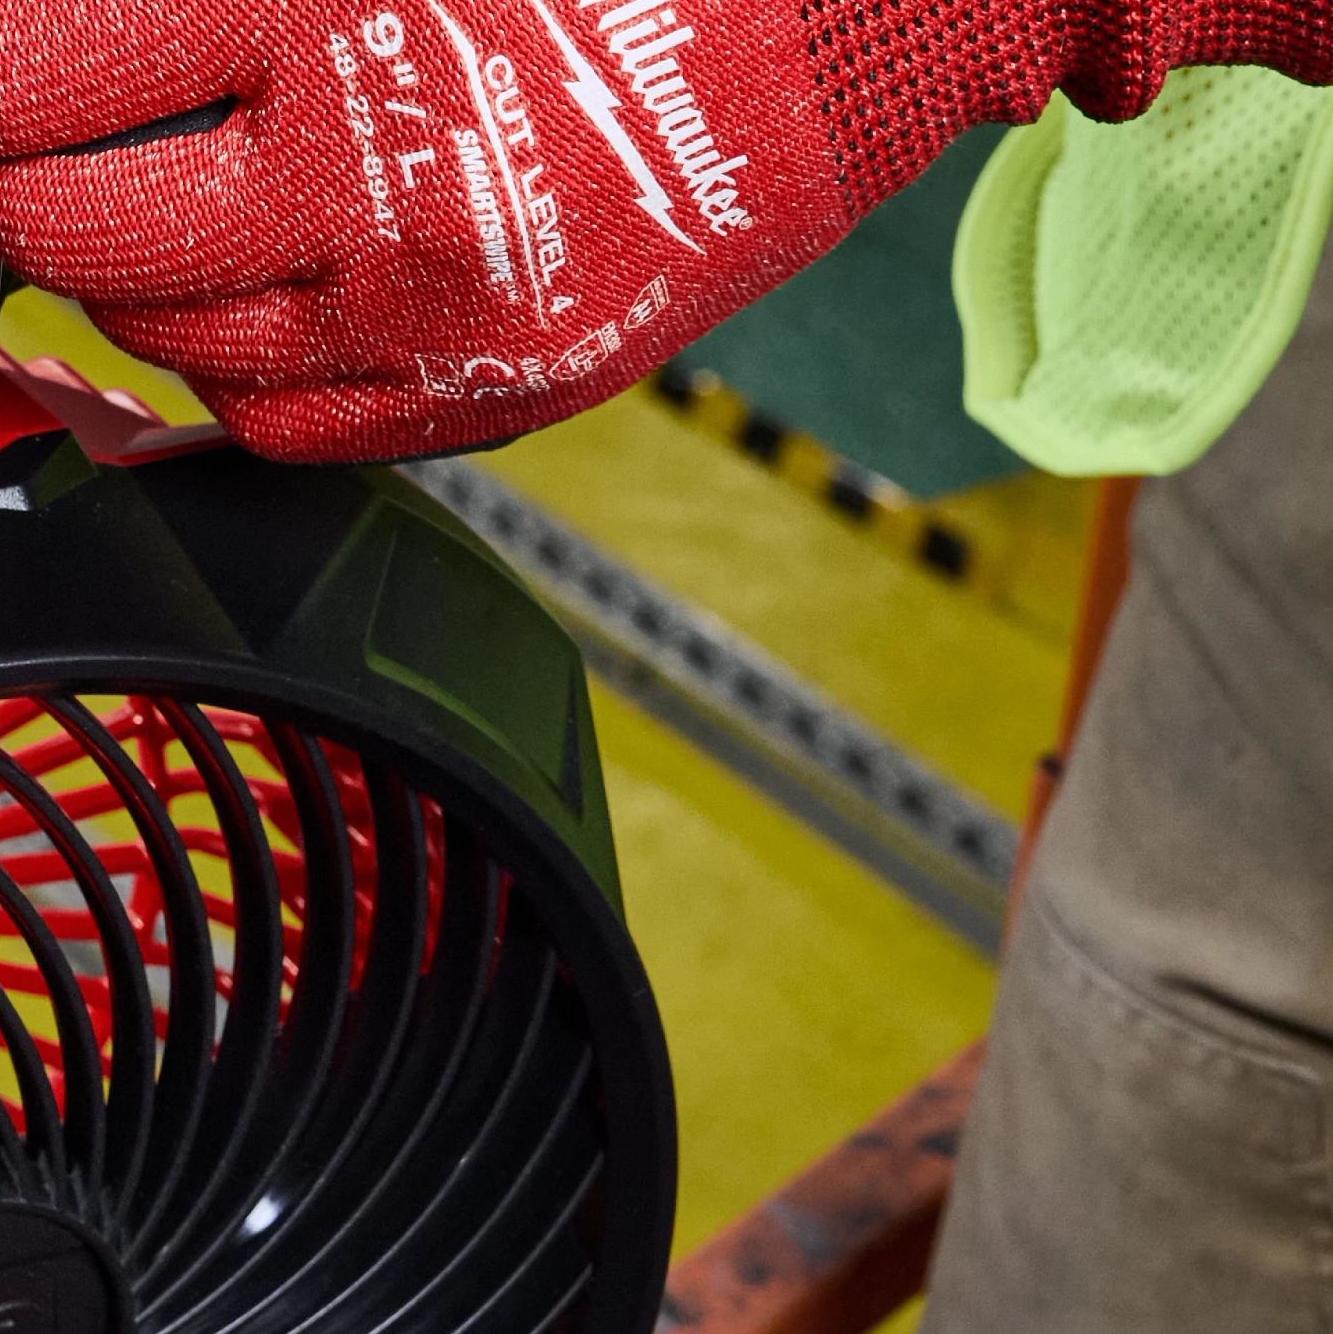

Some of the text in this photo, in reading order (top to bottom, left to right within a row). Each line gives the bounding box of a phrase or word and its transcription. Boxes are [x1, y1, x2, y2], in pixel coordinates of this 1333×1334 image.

[329, 33, 402, 243] 48-22-8947
[484, 54, 575, 315] CUT LEVEL 4
